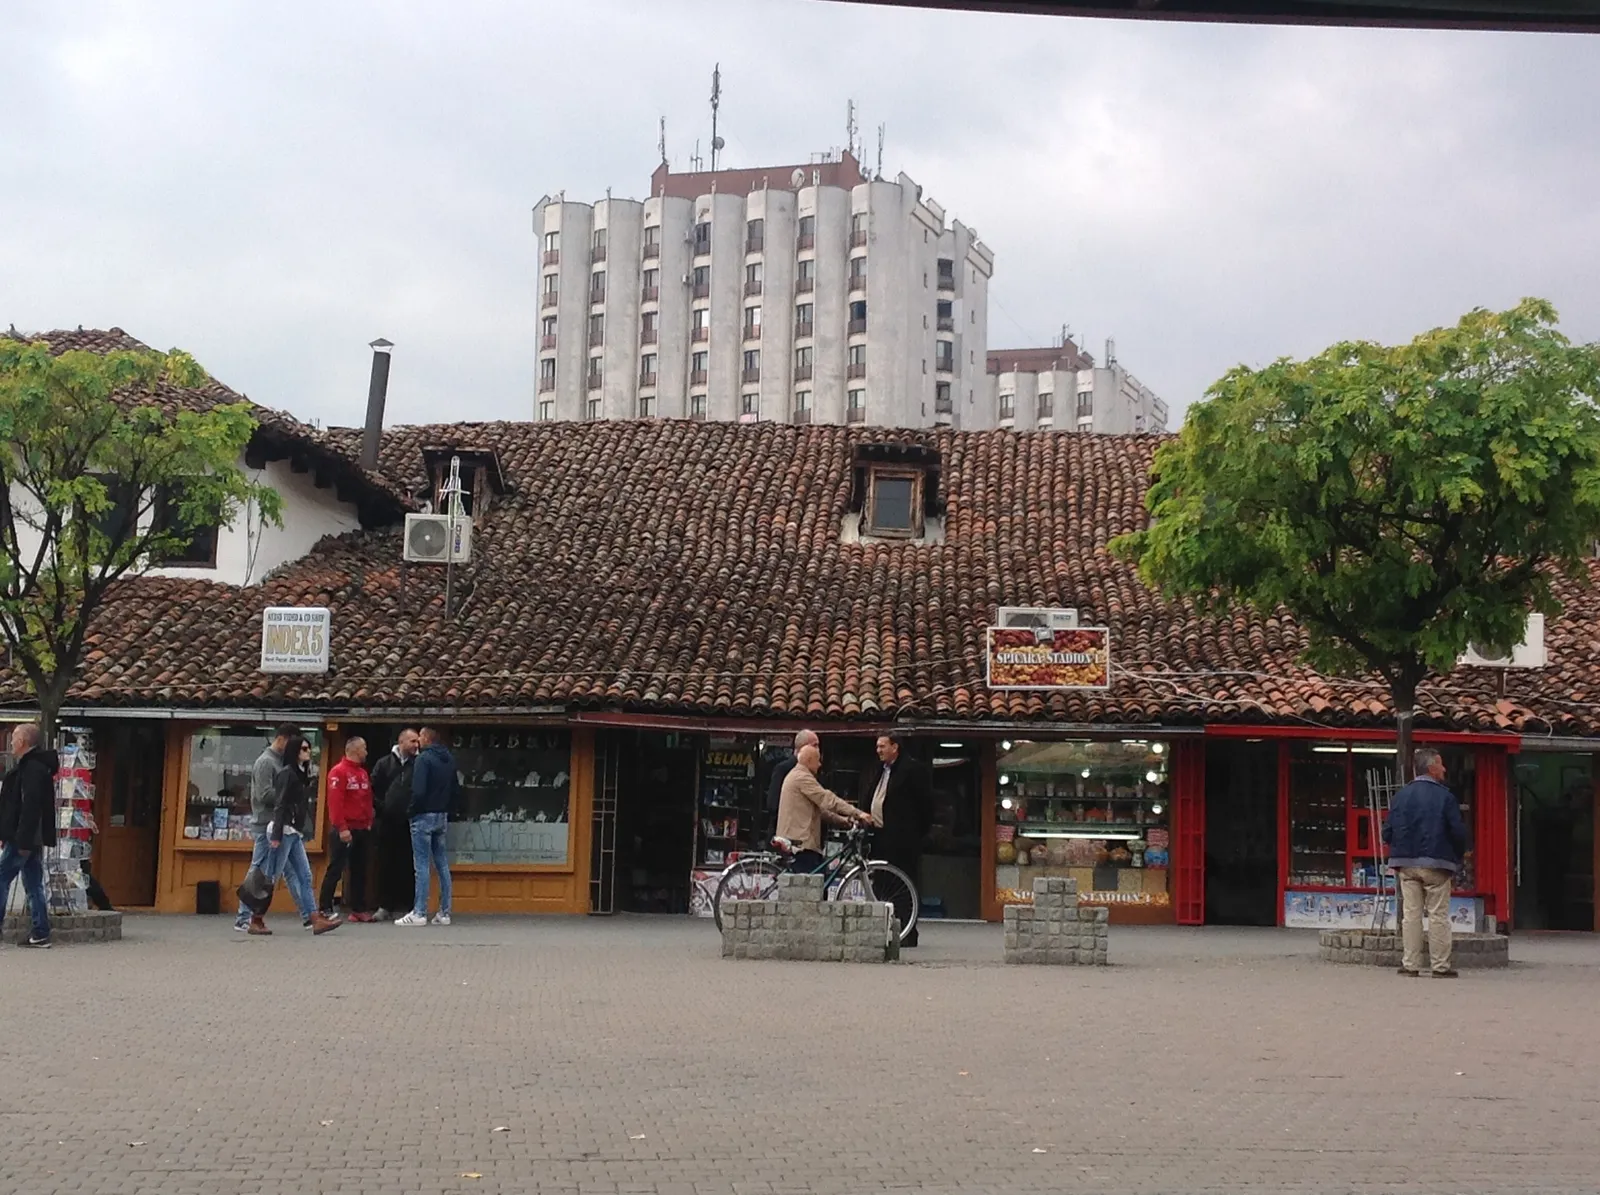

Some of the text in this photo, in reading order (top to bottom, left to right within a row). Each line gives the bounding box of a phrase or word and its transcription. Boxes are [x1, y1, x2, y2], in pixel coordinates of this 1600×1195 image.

[266, 624, 324, 656] INDEX 5
[1046, 652, 1092, 664] STADION
[706, 752, 753, 766] SELMA
[1080, 892, 1141, 903] STADION
